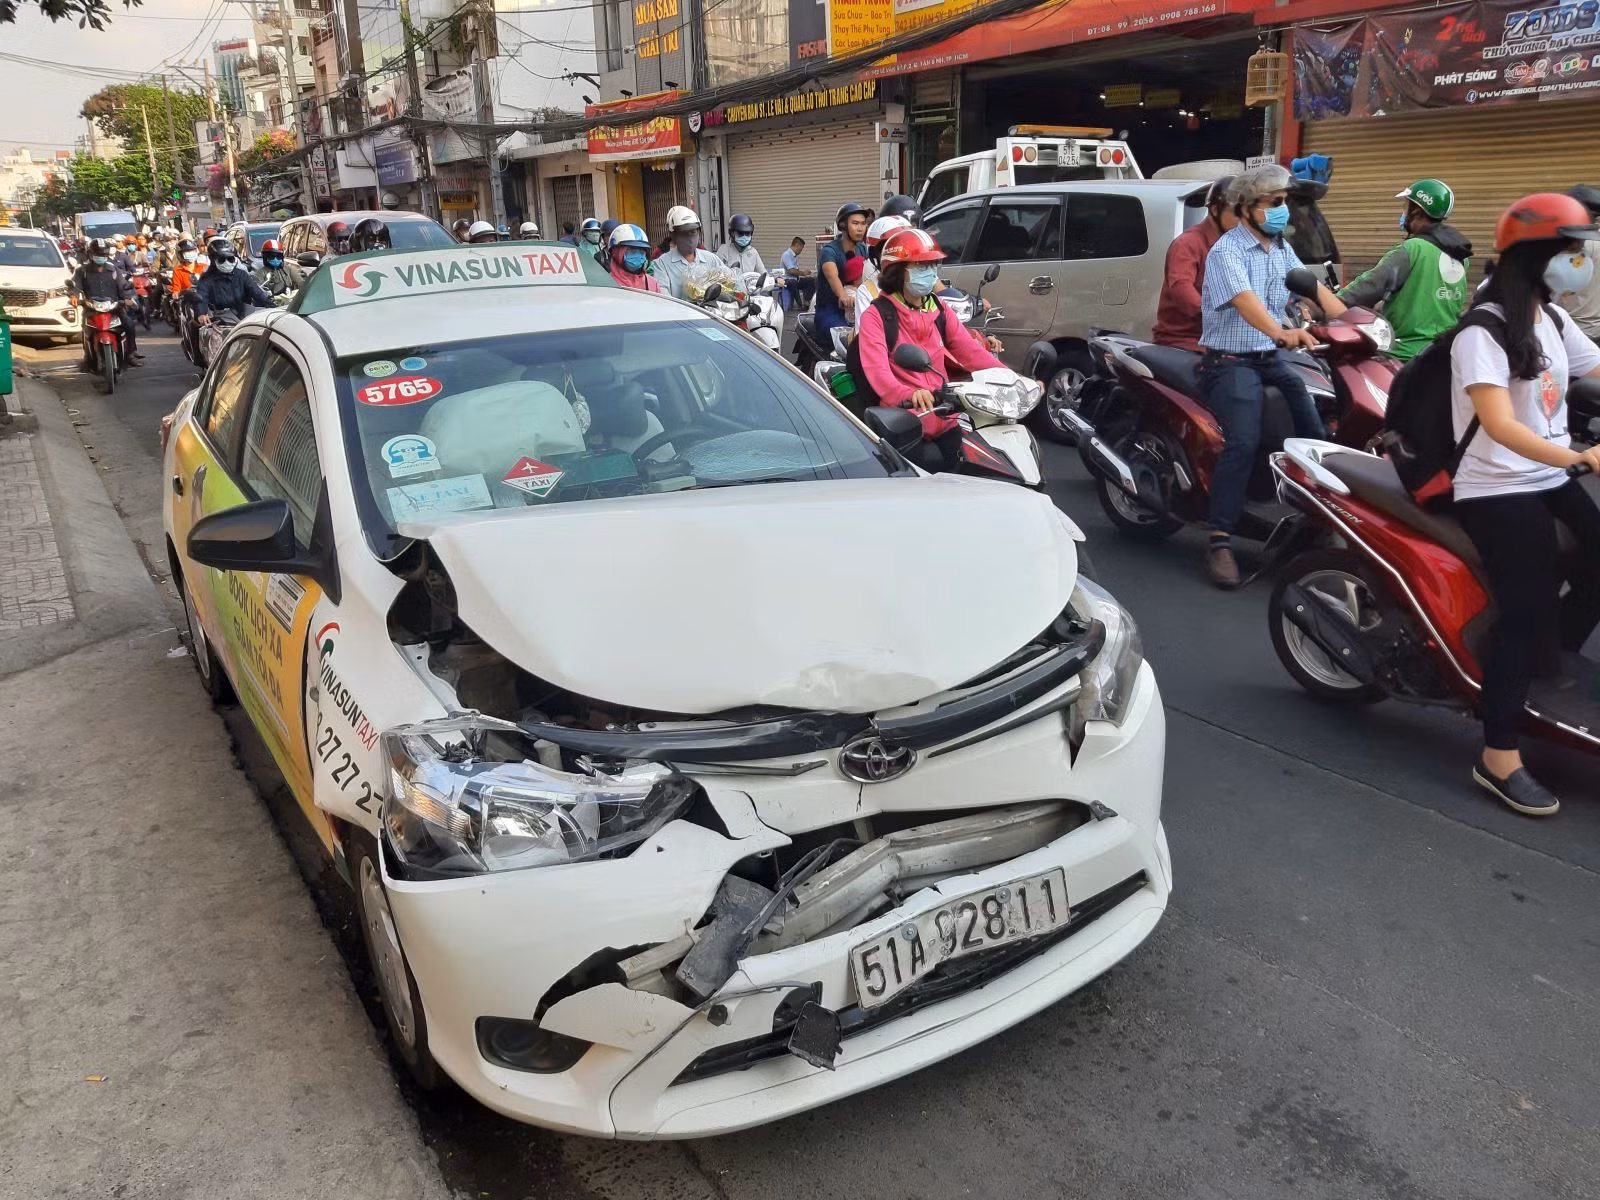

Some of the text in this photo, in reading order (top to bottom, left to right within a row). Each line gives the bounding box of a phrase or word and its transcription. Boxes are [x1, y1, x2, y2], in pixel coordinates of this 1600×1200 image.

[635, 3, 656, 25] MUA
[1118, 21, 1128, 29] 99
[1436, 15, 1456, 41] 2
[828, 85, 849, 107] TRANG
[850, 81, 862, 102] CAO
[1415, 190, 1433, 206] Grab
[365, 379, 433, 402] 5765
[522, 478, 551, 489] TAXI
[269, 623, 283, 668] XA
[316, 727, 342, 763] 27
[331, 752, 361, 792] 27
